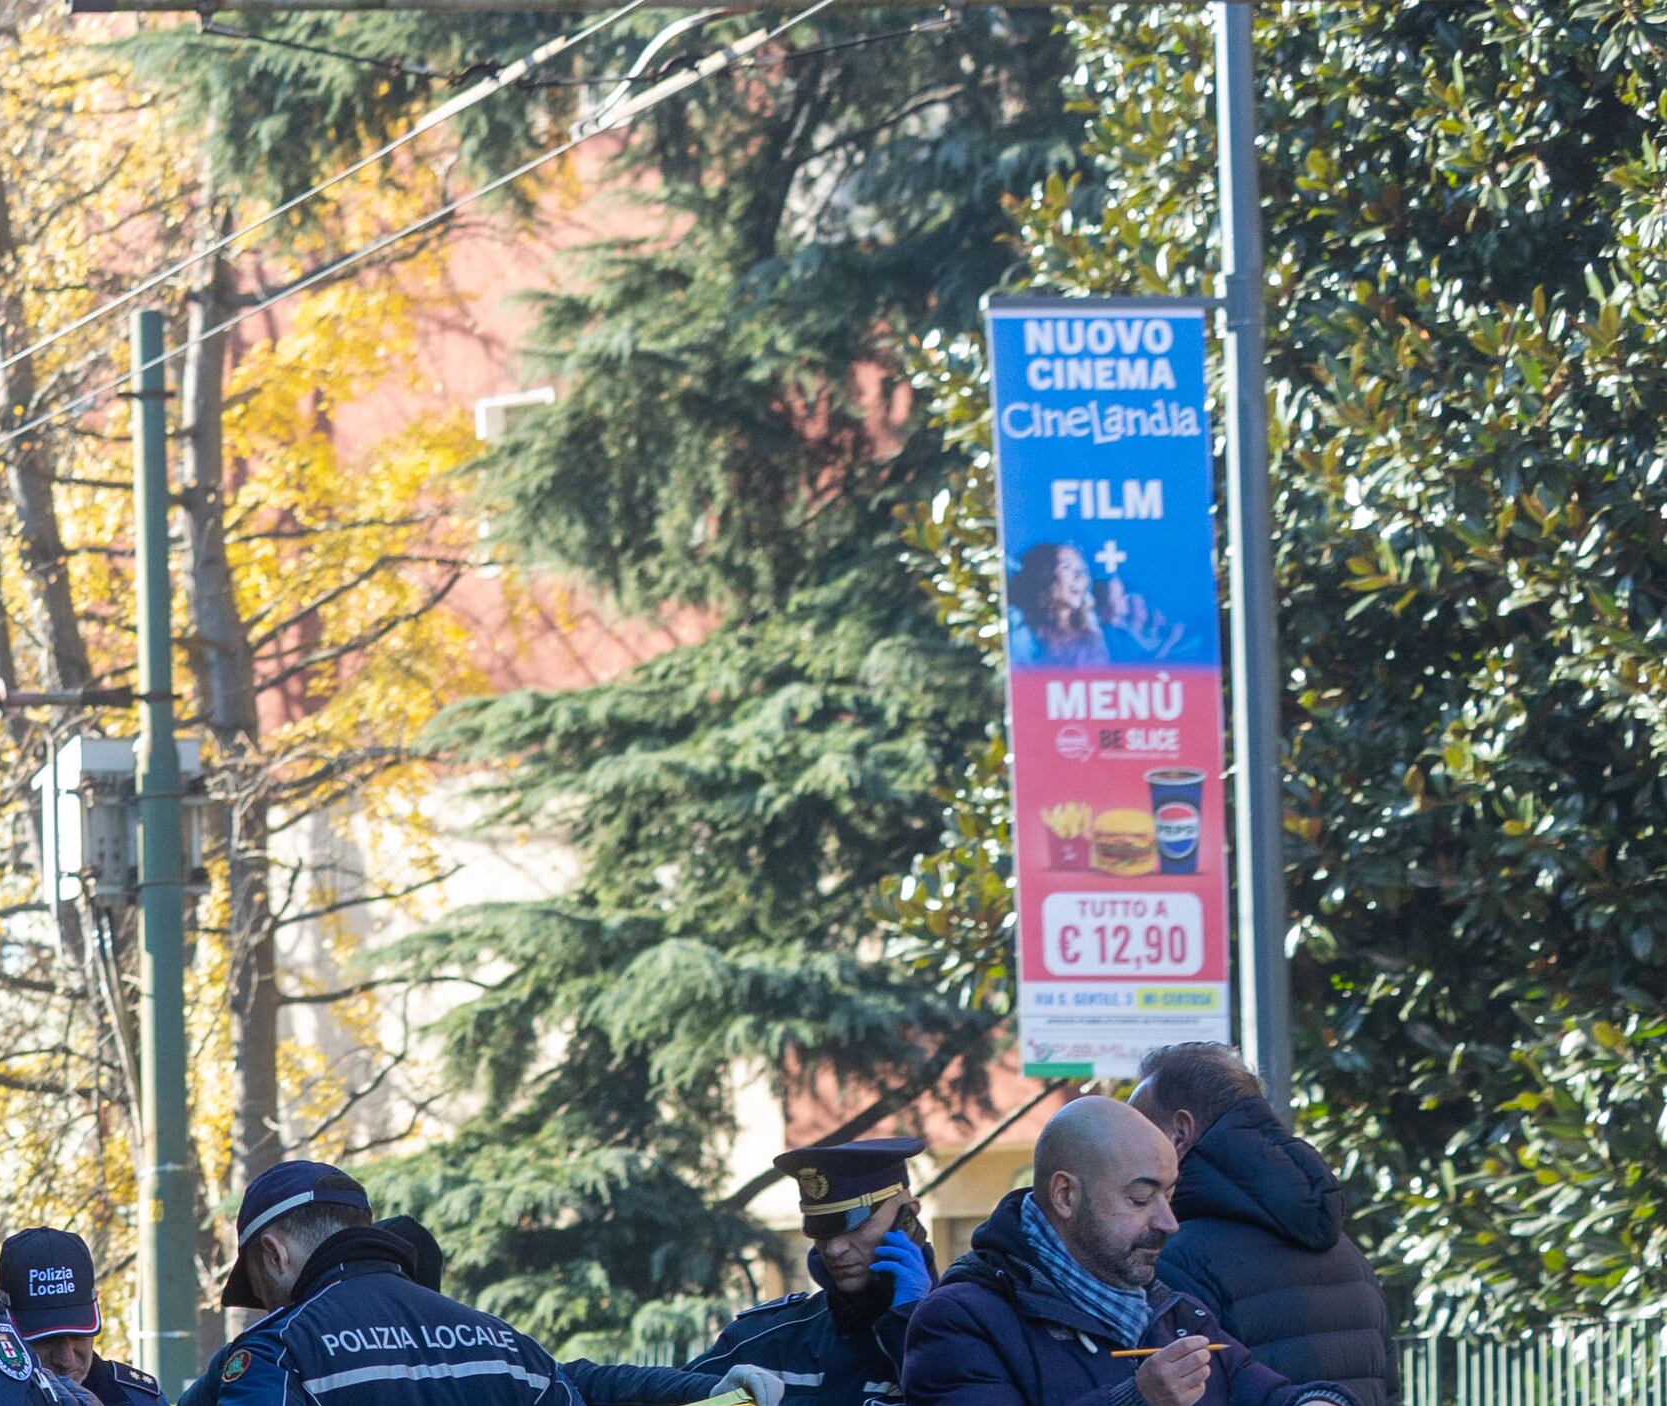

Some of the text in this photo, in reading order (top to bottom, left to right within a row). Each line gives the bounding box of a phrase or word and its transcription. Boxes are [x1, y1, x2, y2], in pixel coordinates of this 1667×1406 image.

[1024, 319, 1174, 355] NUOVO
[1027, 358, 1176, 391] CINEMA
[1051, 479, 1164, 520] FILM
[1046, 672, 1184, 721] MENÙ
[1076, 899, 1169, 918] TUTTO A
[1058, 925, 1188, 971] € 12,90
[29, 1267, 74, 1283] Polizia
[29, 1280, 75, 1297] Locale
[321, 1324, 519, 1356] POLIZIA LOCALE
